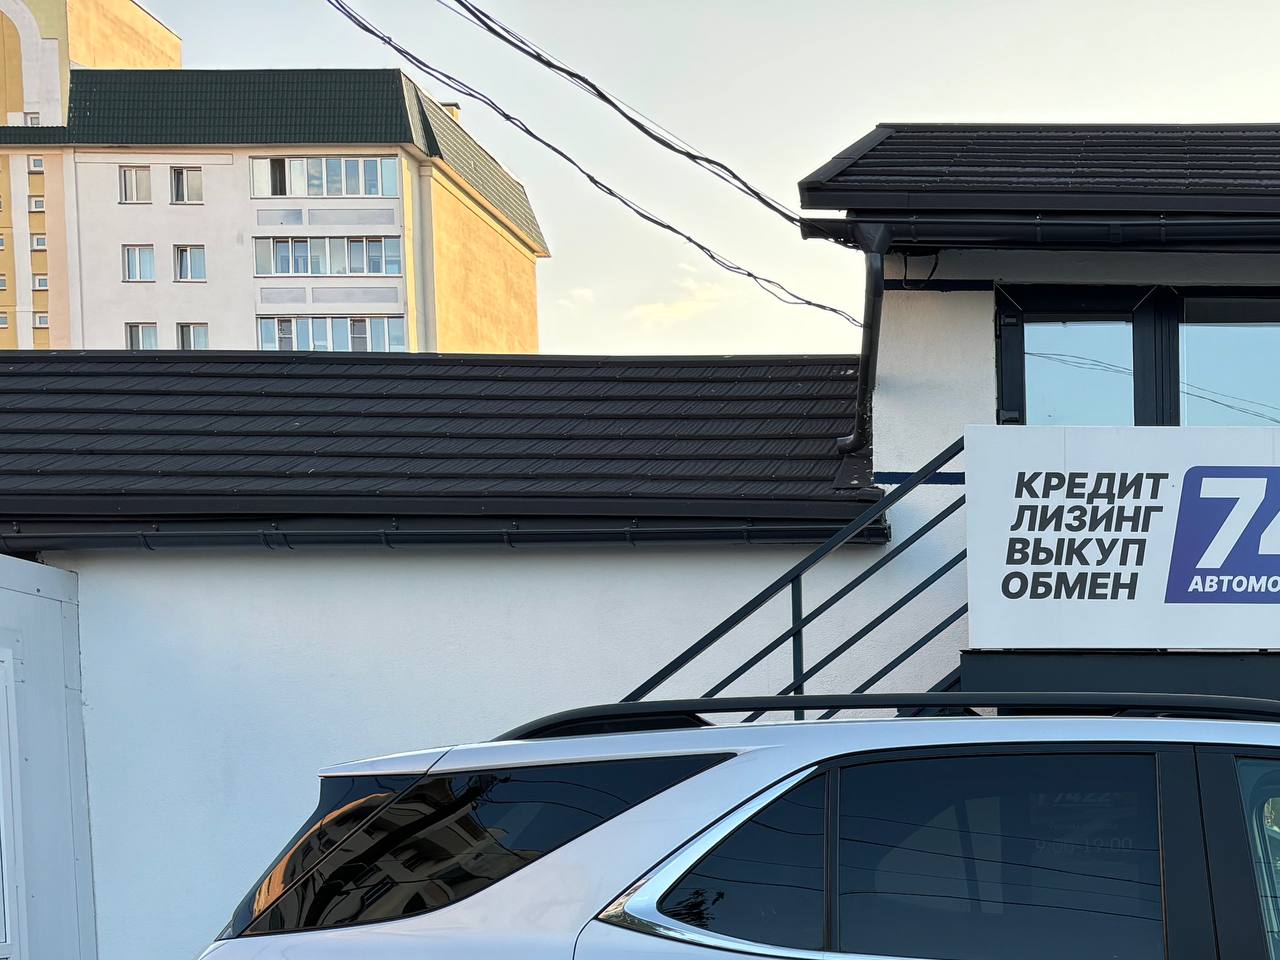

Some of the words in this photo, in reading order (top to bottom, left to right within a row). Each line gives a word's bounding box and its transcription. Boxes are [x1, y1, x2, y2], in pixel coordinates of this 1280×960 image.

[1015, 472, 1169, 506] КРЕДИТ
[1010, 505, 1163, 533] ЛИЗИНГ
[1005, 537, 1147, 567] ВЫКУП
[1001, 571, 1139, 600] ОБМЕН
